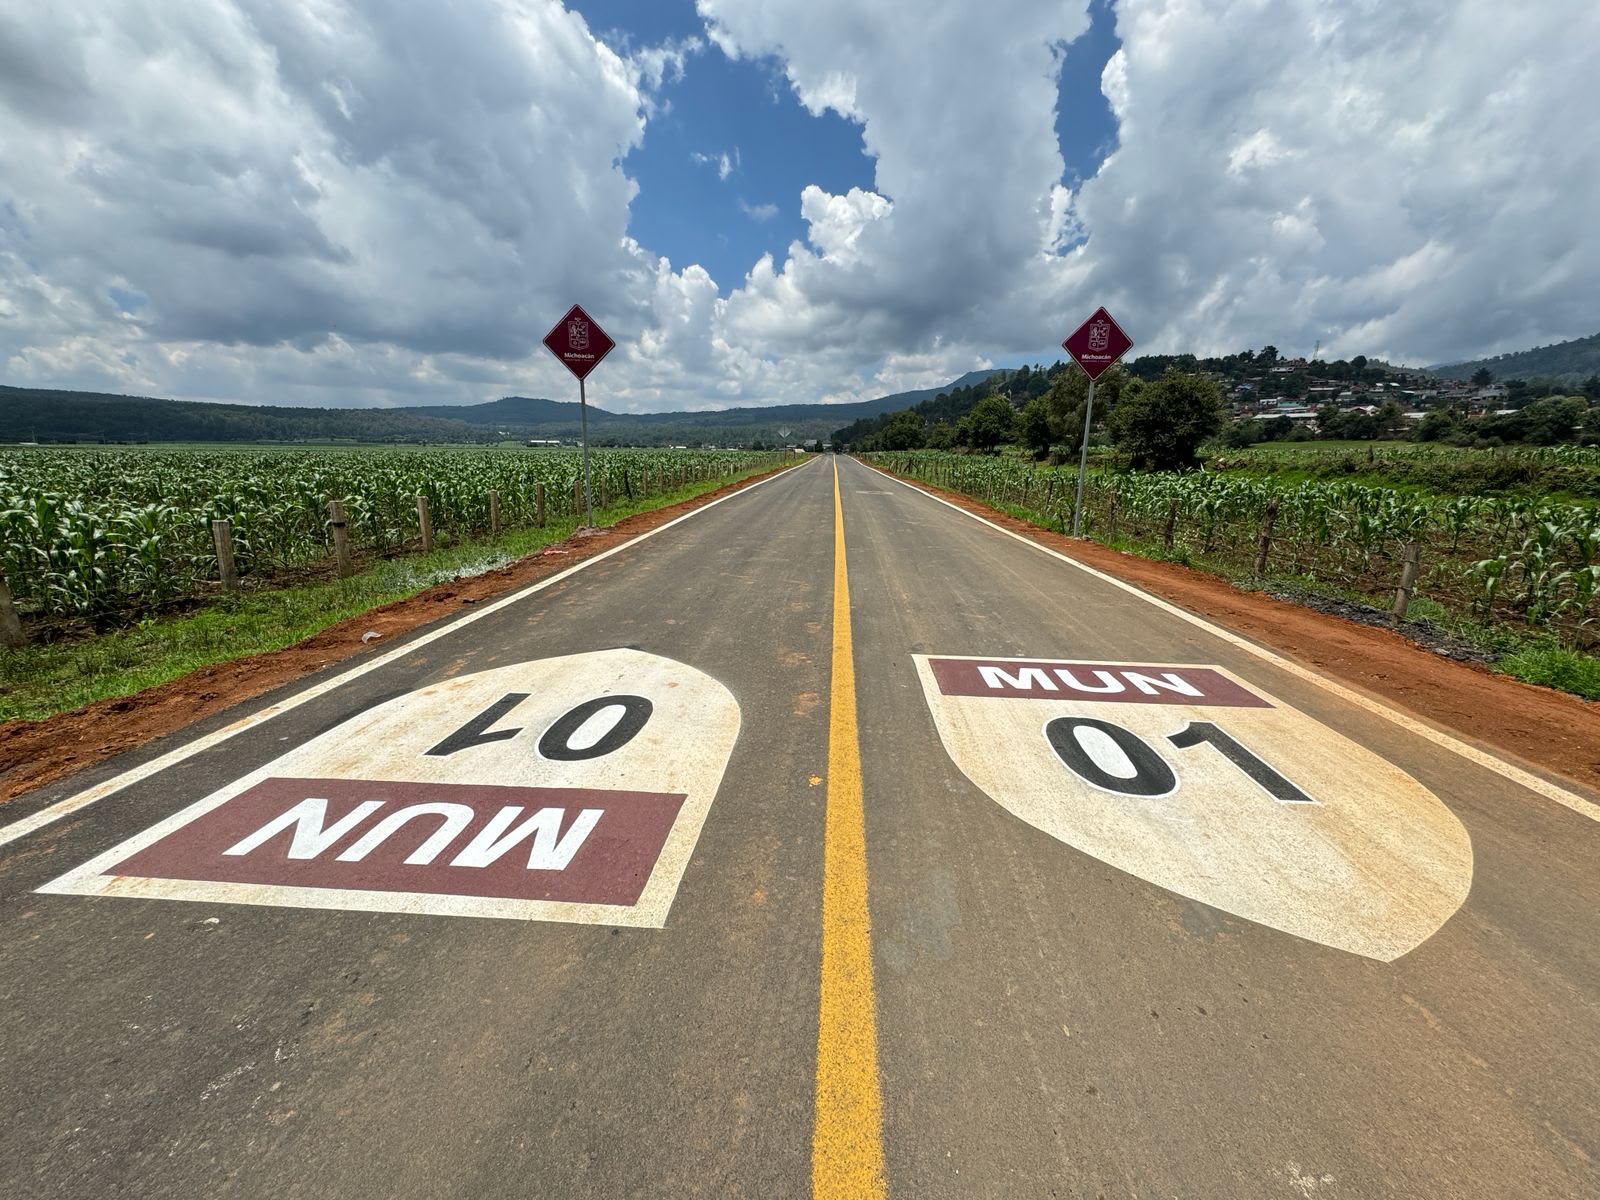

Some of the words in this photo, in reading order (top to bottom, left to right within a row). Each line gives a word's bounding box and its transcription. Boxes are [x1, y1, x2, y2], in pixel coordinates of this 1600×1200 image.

[976, 666, 1205, 697] MUN
[425, 692, 653, 760] 01
[1045, 716, 1315, 803] 01
[223, 797, 604, 871] MUN
